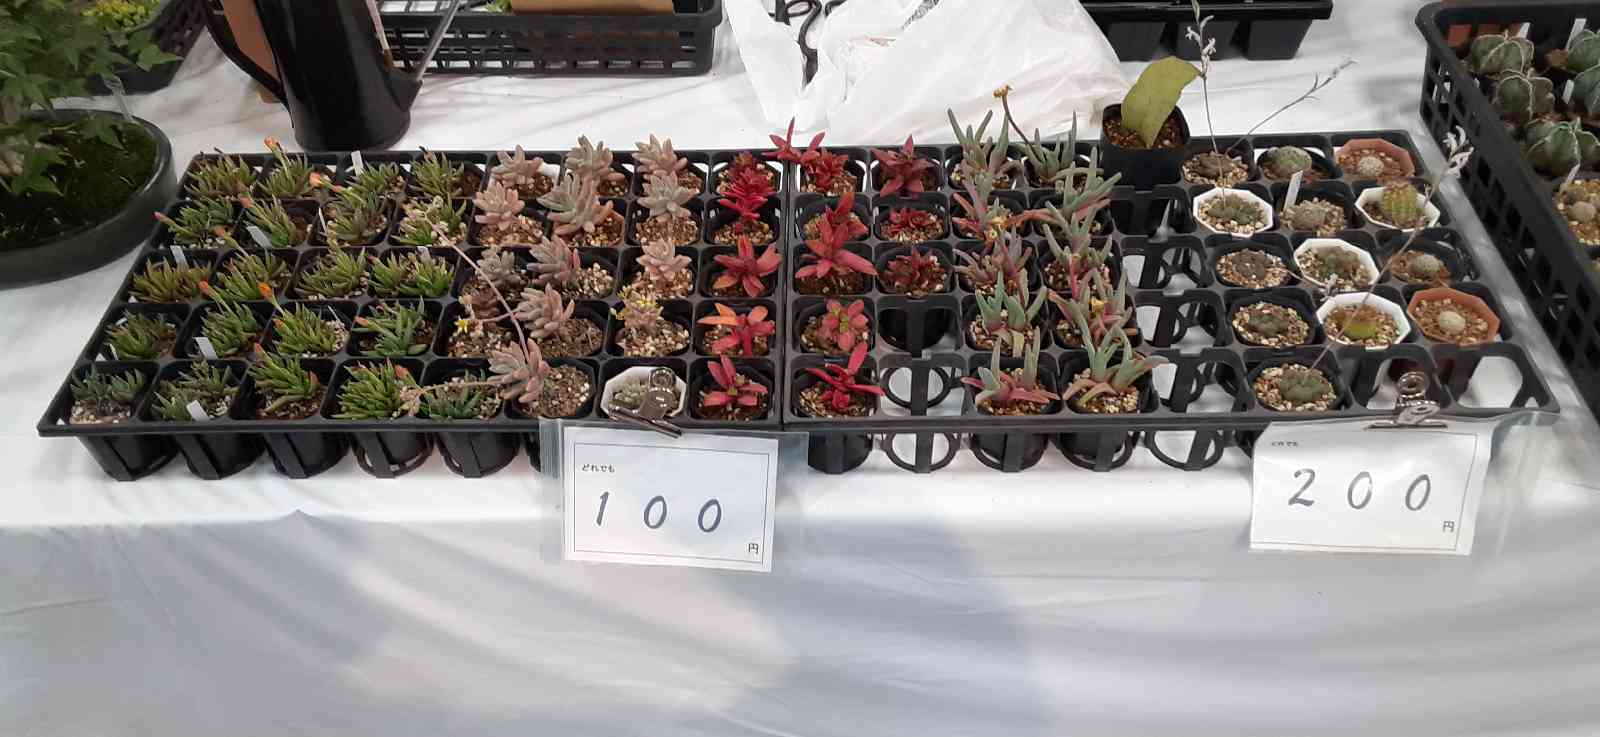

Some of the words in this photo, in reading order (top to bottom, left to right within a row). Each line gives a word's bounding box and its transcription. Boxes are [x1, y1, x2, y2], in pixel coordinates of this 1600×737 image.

[582, 463, 616, 473] どれでも
[1288, 468, 1431, 511] 200
[596, 491, 722, 533] 100
[1442, 520, 1455, 533] 円
[748, 542, 759, 554] 円
